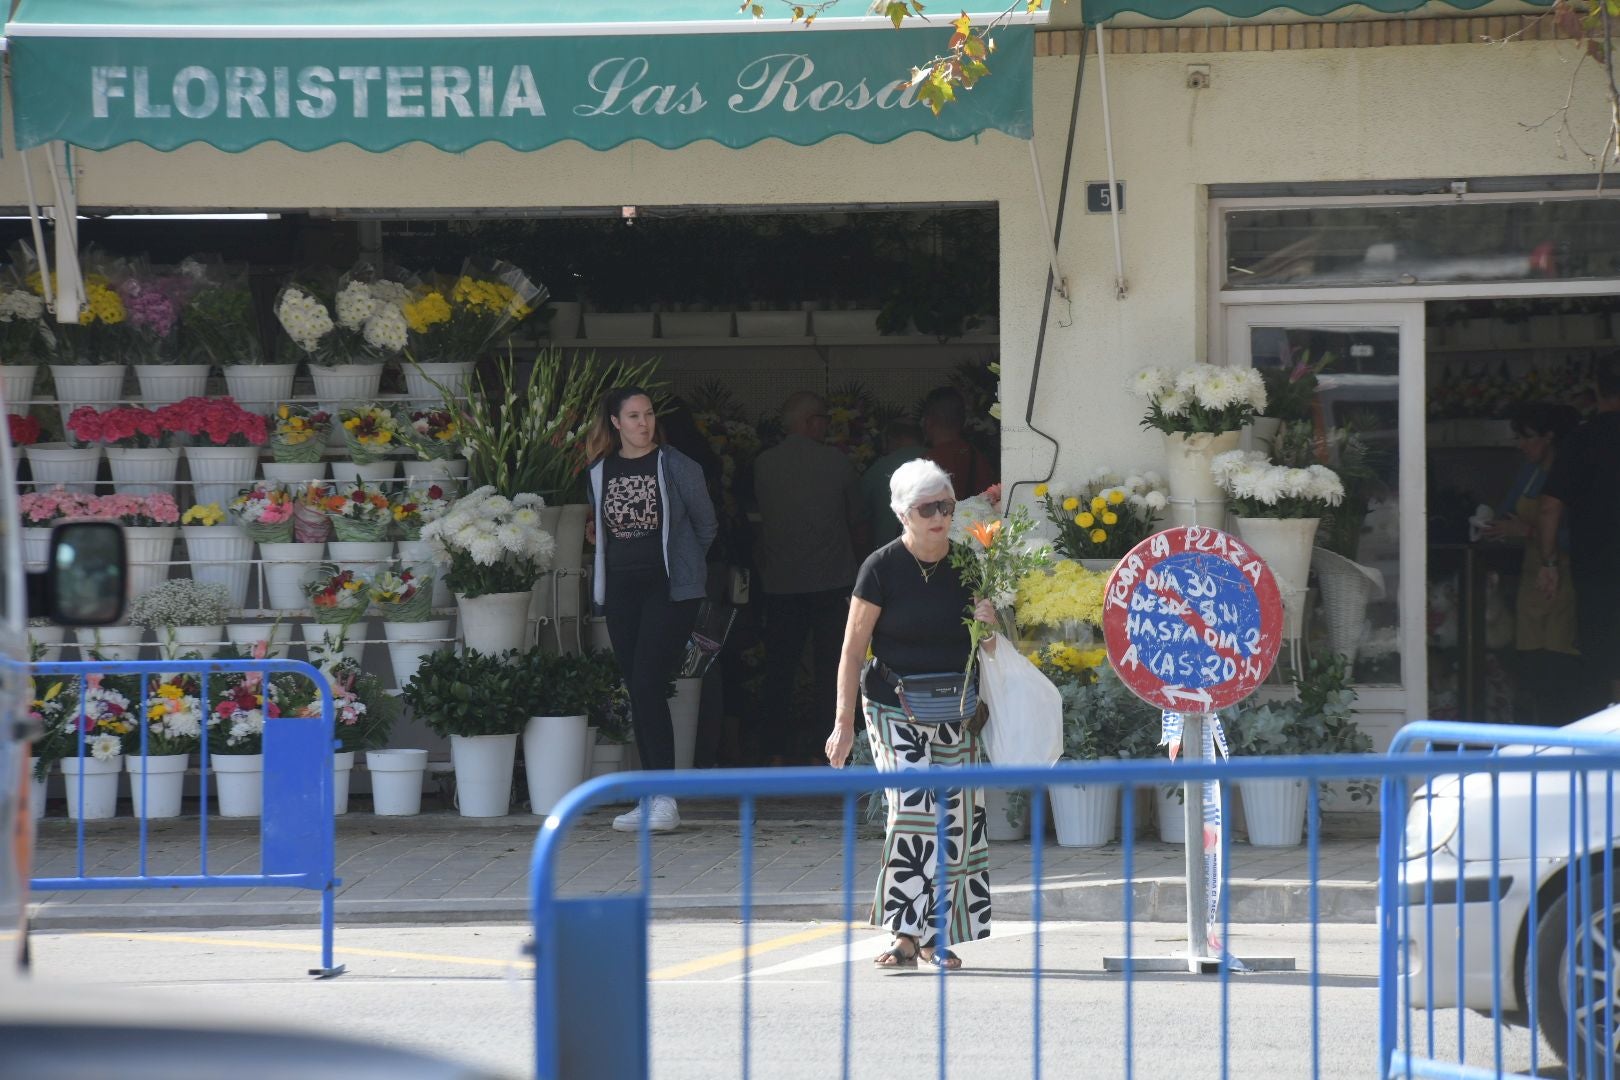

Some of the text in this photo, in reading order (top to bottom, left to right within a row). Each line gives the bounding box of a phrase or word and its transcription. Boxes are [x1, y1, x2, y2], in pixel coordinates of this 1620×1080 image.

[90, 65, 547, 119] FLORISTERIA
[572, 56, 707, 117] Las
[1100, 188, 1111, 207] 5
[1106, 526, 1262, 611] TODA LA PLAZA
[1184, 569, 1217, 598] 30
[1131, 591, 1193, 616] DESDE
[1125, 613, 1199, 645] HASTA
[1243, 627, 1262, 656] 2
[1120, 644, 1140, 672] A
[1149, 649, 1194, 677] LAS
